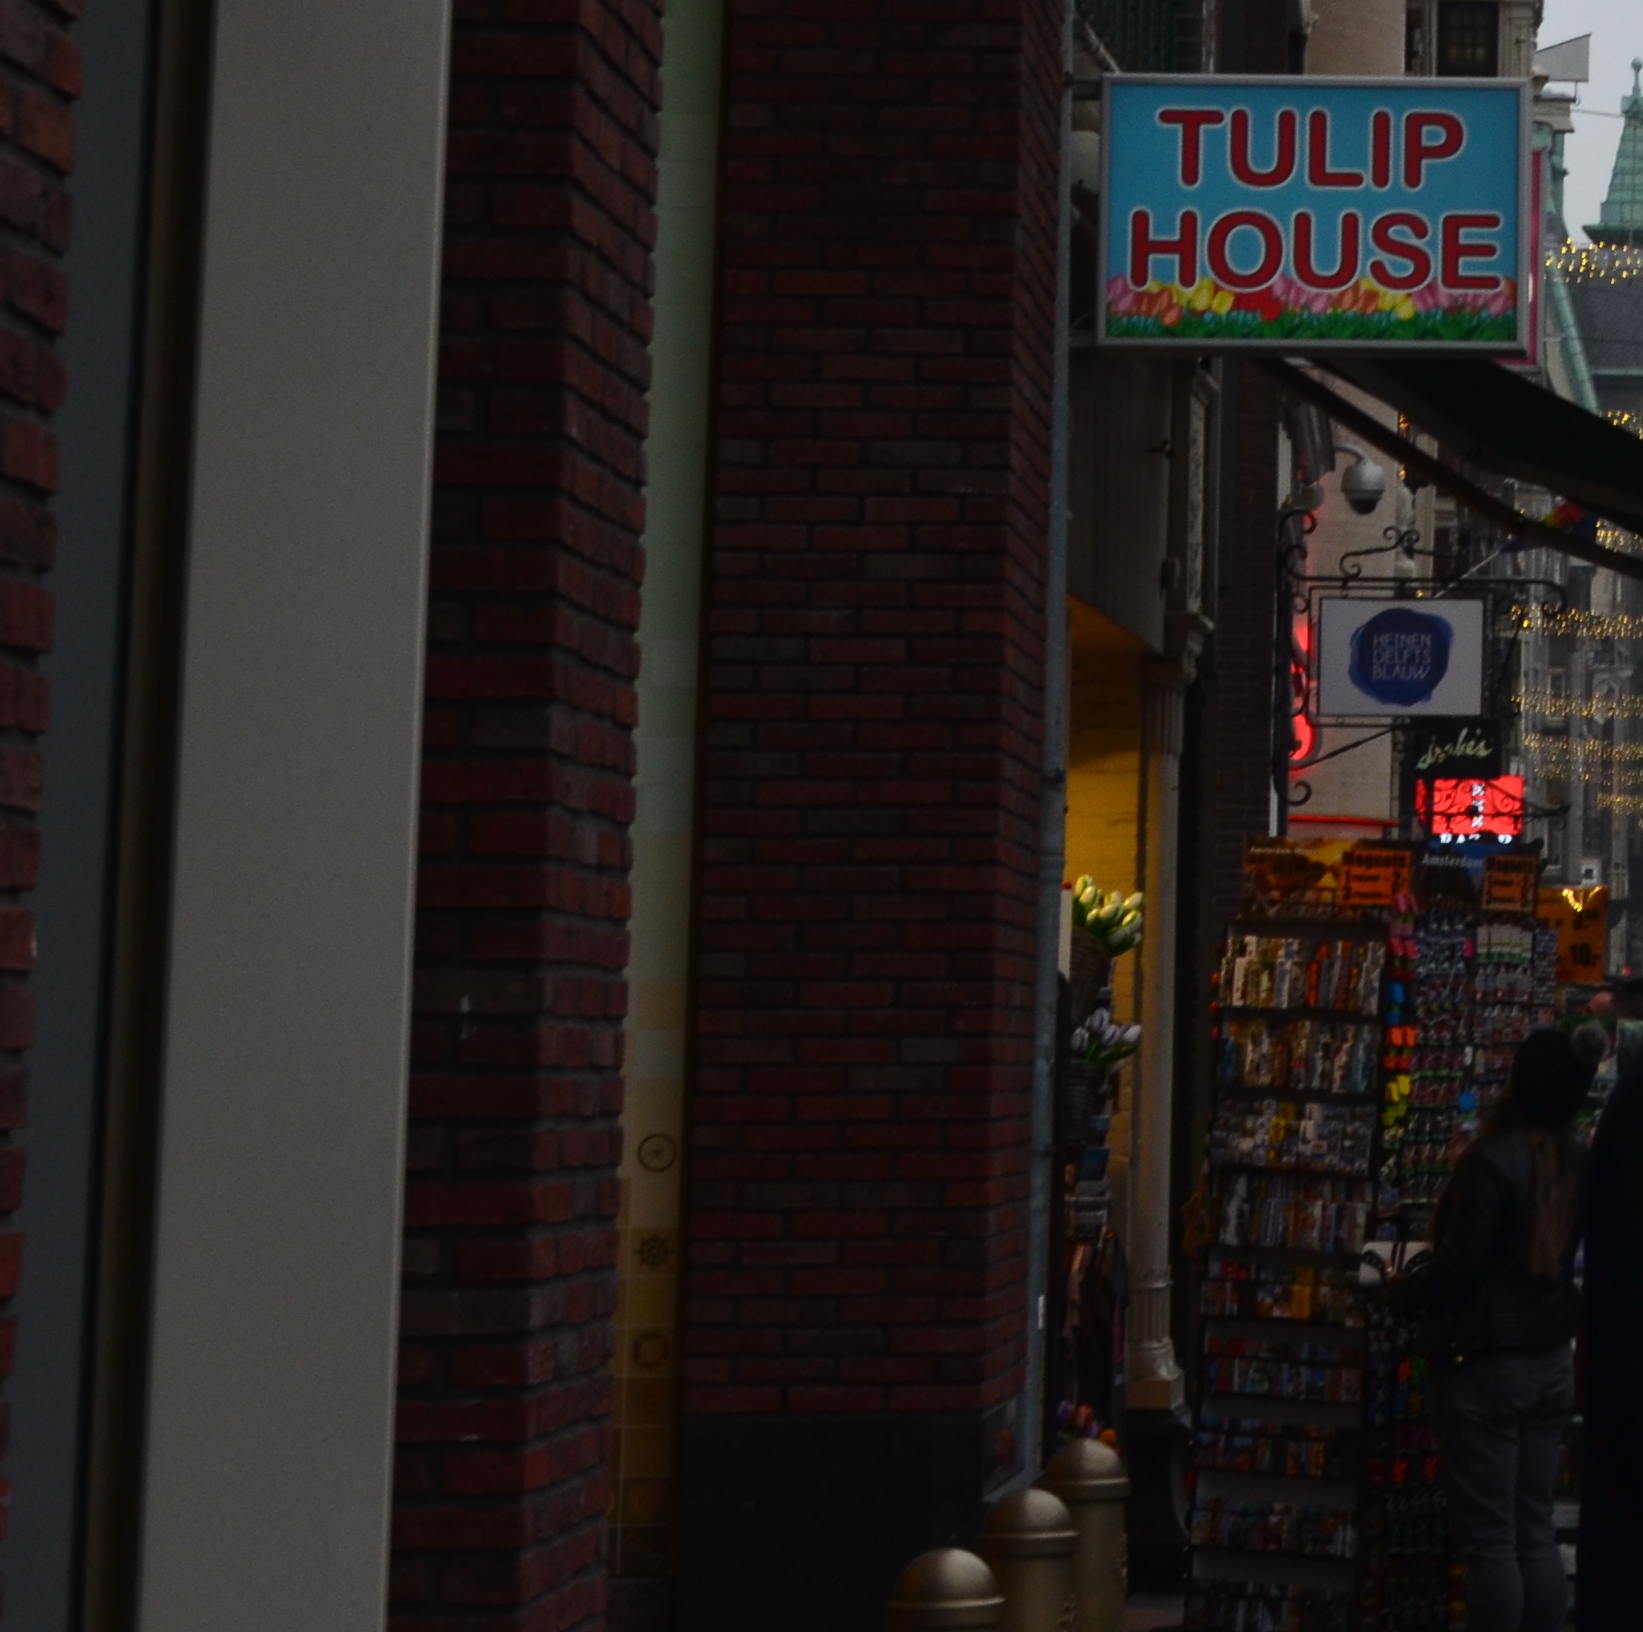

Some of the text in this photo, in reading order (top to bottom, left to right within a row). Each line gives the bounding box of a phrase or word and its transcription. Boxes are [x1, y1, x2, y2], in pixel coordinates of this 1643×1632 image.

[1156, 107, 1466, 190] TULIP
[1128, 207, 1503, 291] HOUSE
[1372, 632, 1432, 649] HEINEN
[1372, 648, 1432, 664] DELFTS
[1372, 664, 1432, 681] BLAUW
